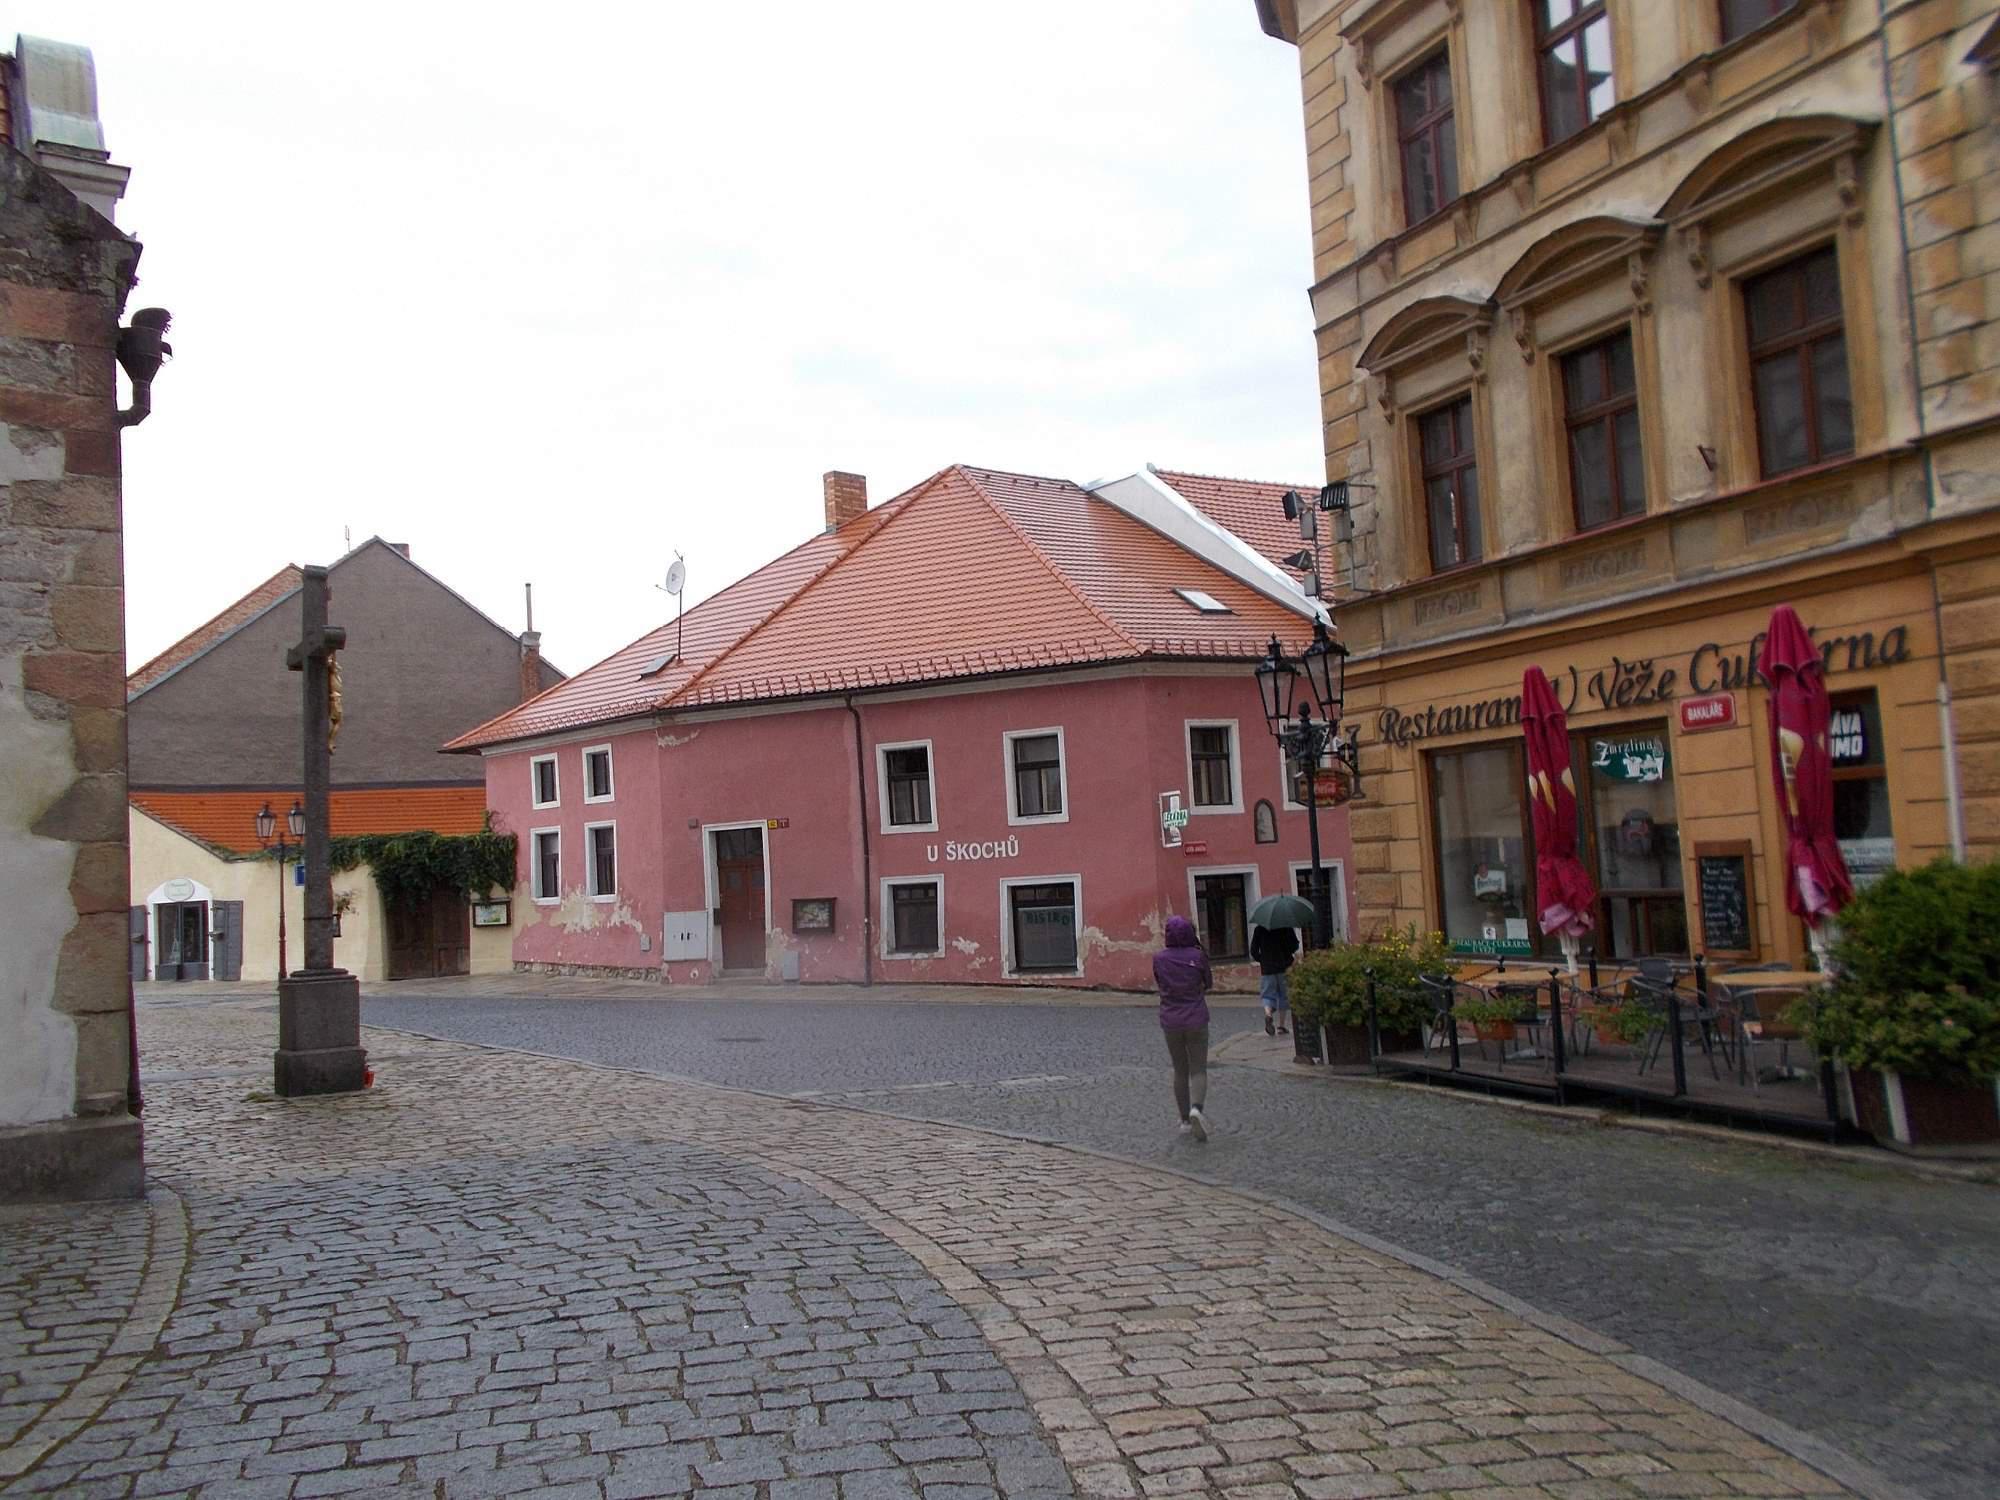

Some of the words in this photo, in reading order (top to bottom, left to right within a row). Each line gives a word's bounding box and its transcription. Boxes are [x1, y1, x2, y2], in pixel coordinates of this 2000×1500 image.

[1379, 695, 1522, 748] Restauran
[1587, 656, 1675, 710] Věže
[1831, 710, 1862, 735] ÁVA
[927, 845, 938, 862] U
[946, 834, 1019, 861] ŠKOCHŮ
